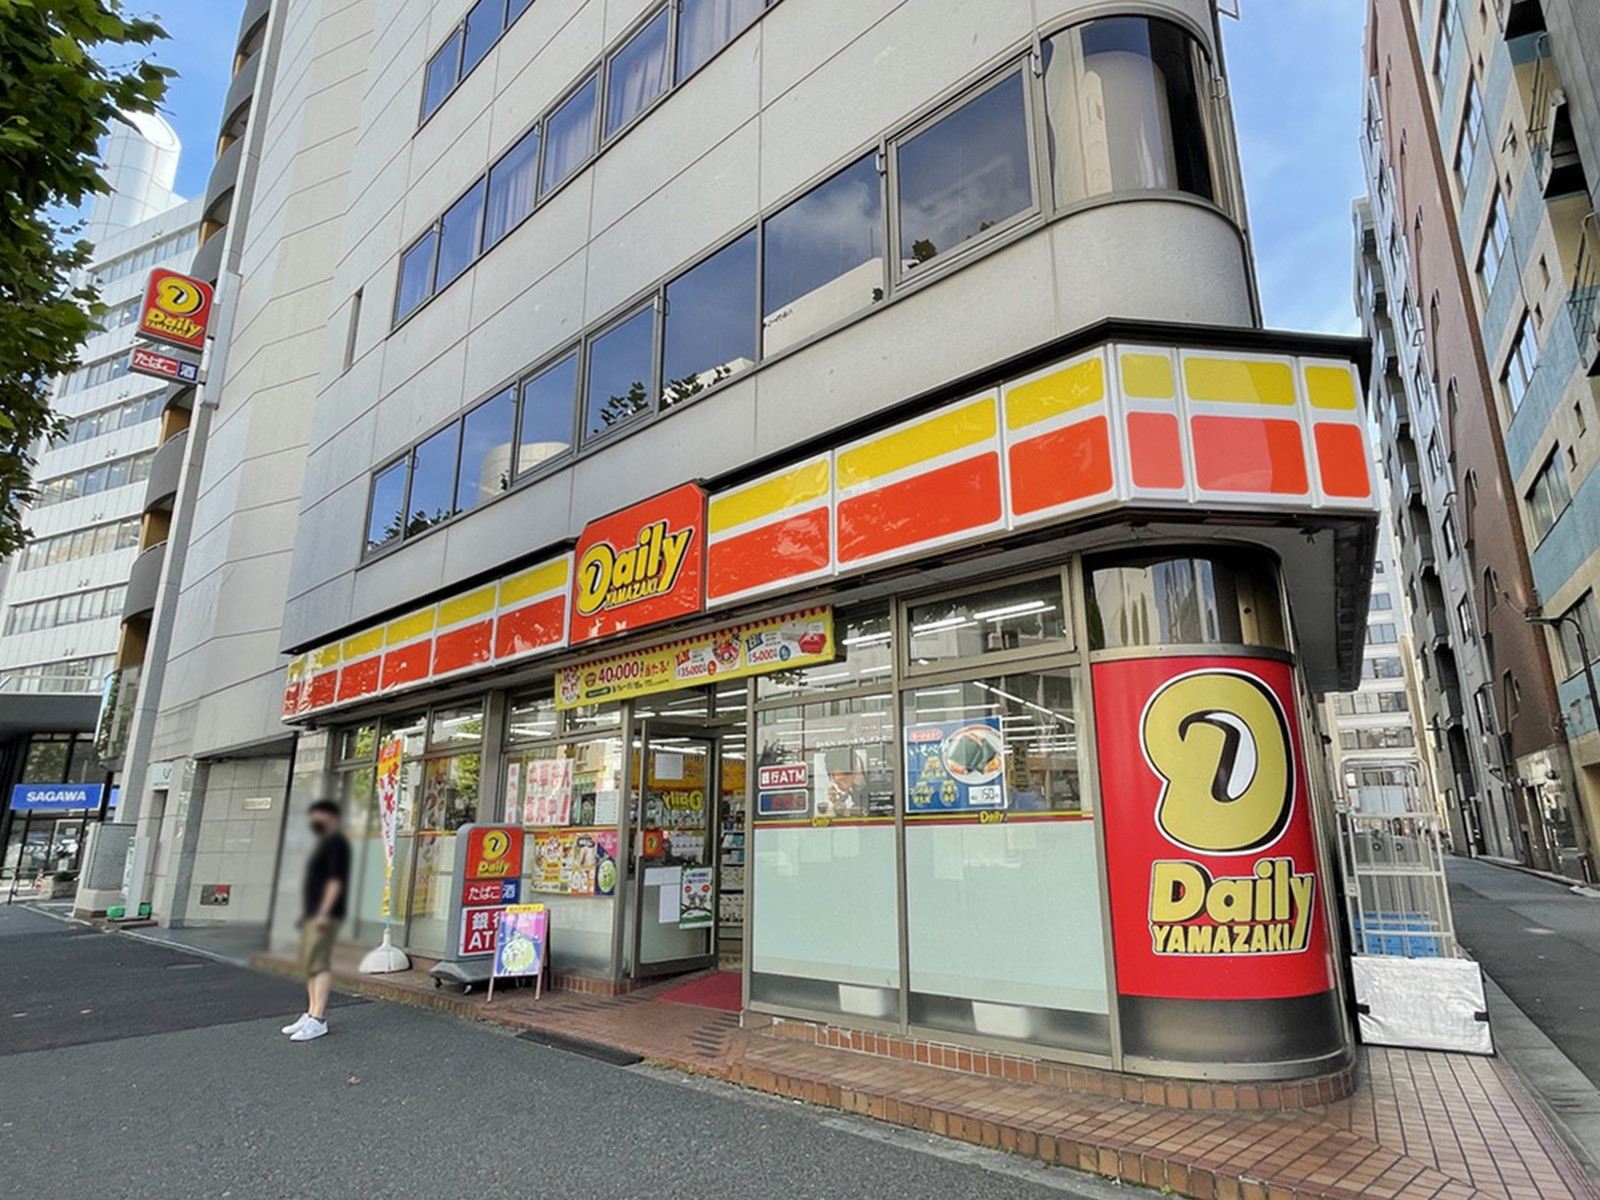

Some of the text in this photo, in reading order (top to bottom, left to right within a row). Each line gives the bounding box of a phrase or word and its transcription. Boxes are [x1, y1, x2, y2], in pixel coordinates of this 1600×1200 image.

[145, 308, 204, 338] Daily
[134, 352, 177, 374] たばこ
[577, 520, 693, 615] Daily
[606, 578, 660, 607] YAMAZAKI
[27, 790, 87, 802] SAGAWA
[478, 861, 510, 876] Daily
[468, 884, 516, 901] たばこ 酒
[1152, 860, 1313, 950] Daily
[468, 930, 497, 950] AT
[1152, 924, 1290, 953] YAMAZAKI
